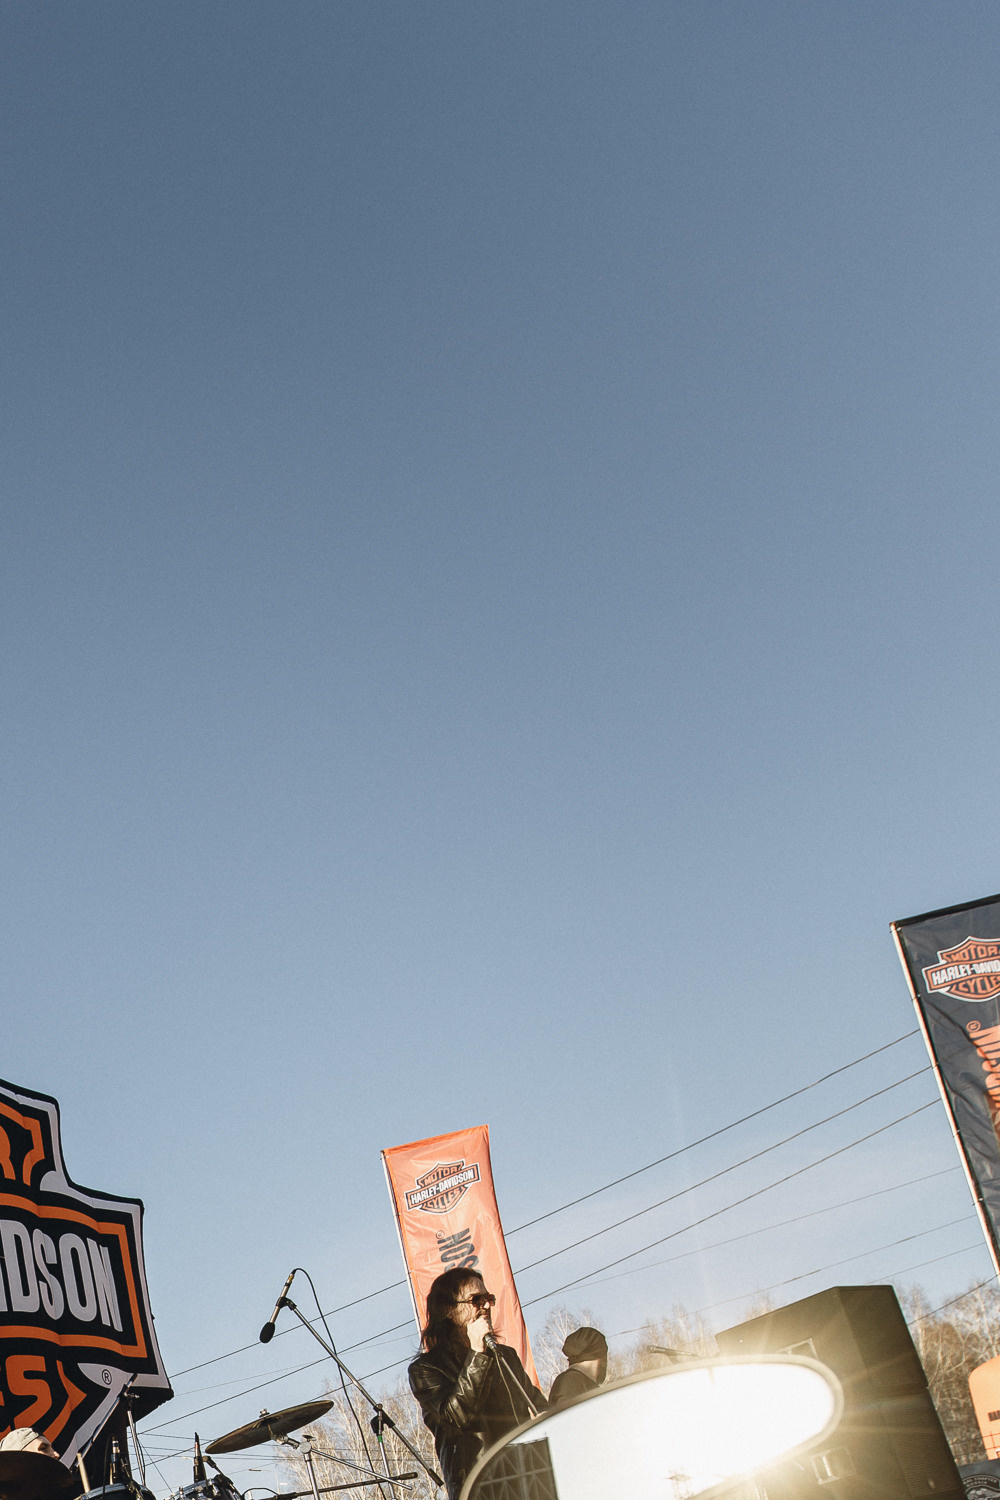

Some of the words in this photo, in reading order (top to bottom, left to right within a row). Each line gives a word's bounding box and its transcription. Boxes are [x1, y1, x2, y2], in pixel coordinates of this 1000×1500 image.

[950, 945, 999, 961] MOTOR
[932, 958, 1000, 986] HARLEY-DAVID
[958, 975, 1000, 994] CYCLE
[424, 1165, 457, 1186] MOTOR
[410, 1168, 475, 1205] HARLEY-DAVIDSON
[426, 1188, 461, 1209] CYCLES
